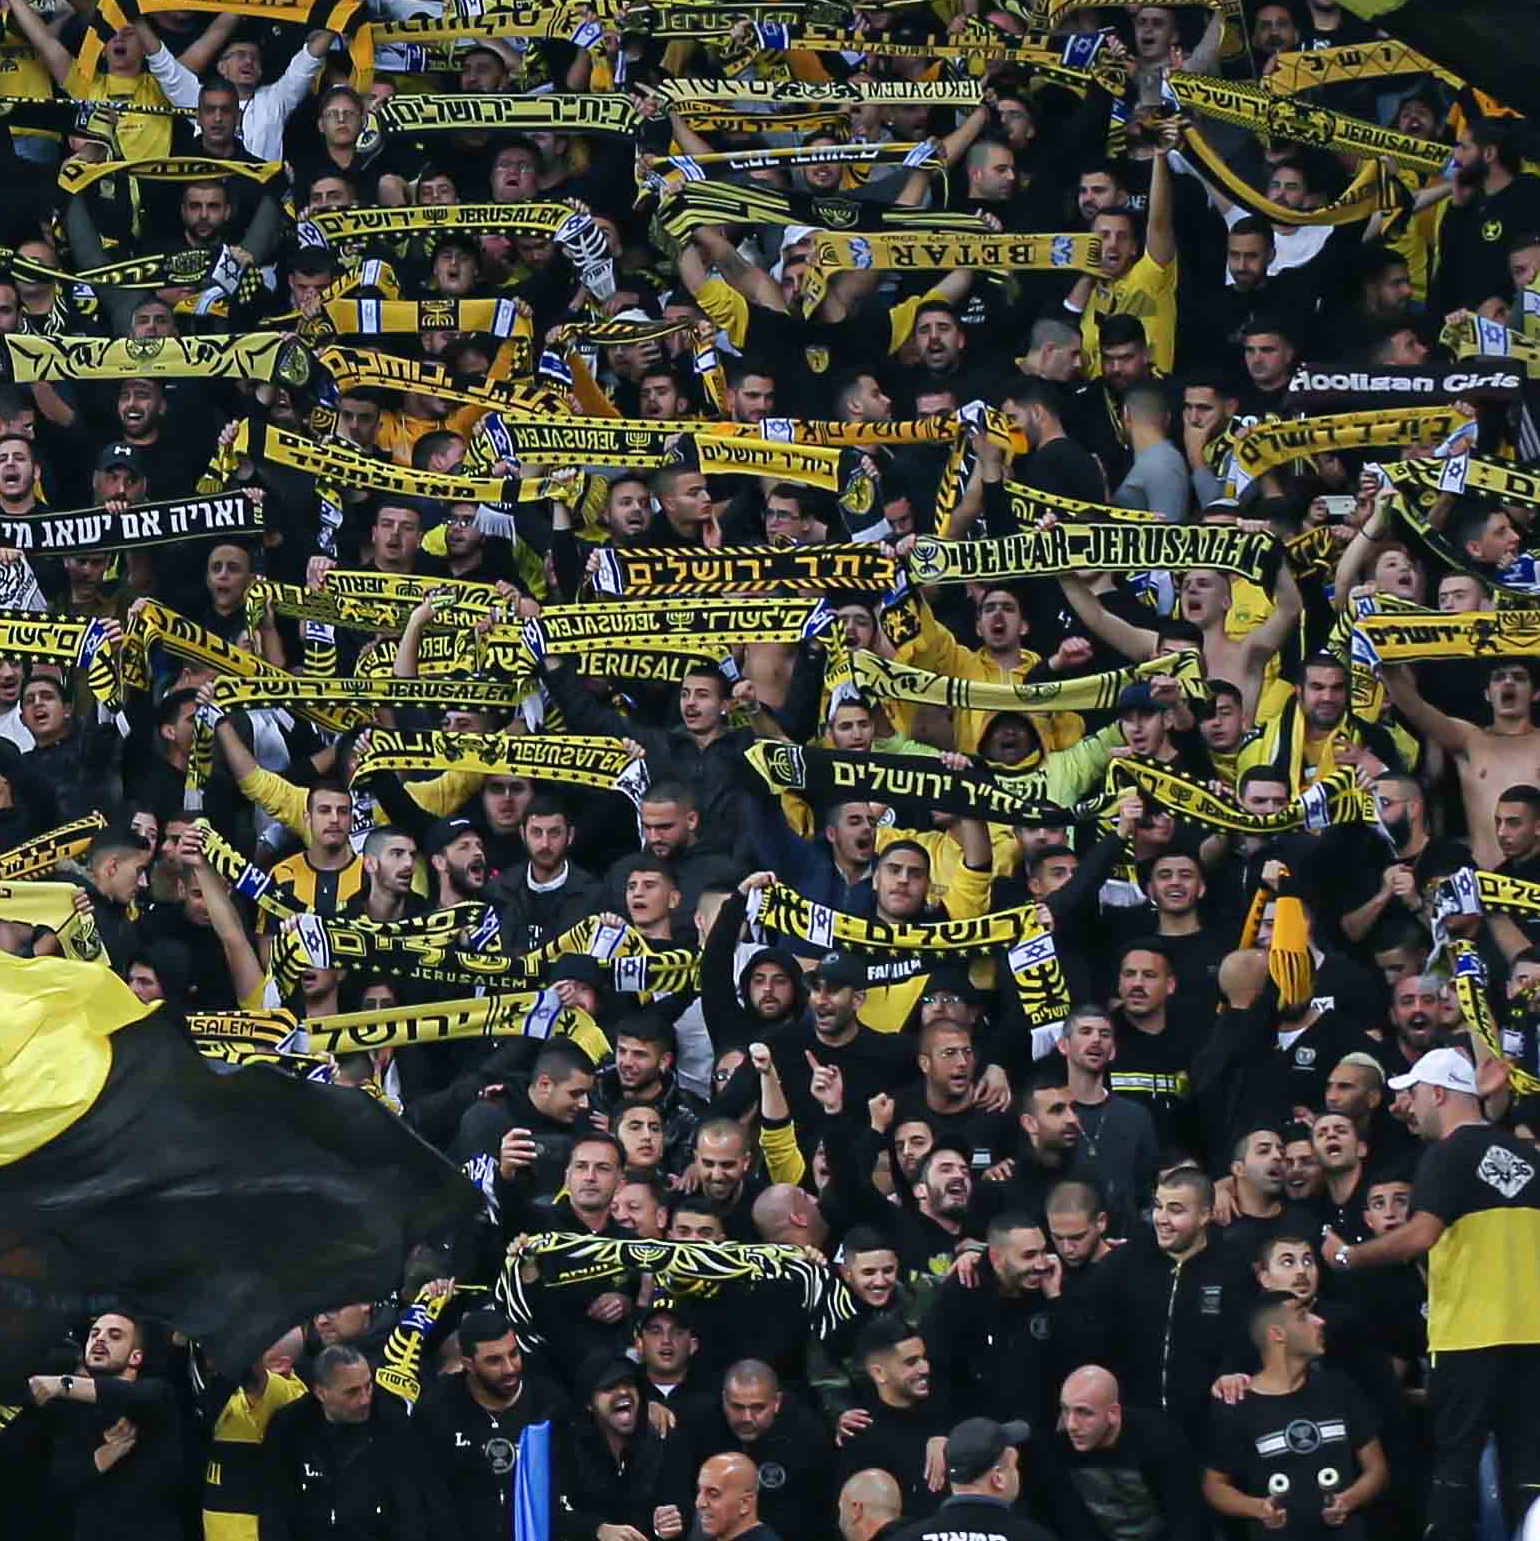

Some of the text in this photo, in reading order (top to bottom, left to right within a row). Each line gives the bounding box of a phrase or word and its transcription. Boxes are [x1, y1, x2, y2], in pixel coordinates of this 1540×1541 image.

[1174, 83, 1270, 121] ירושלים
[1336, 123, 1450, 164] JERUSALEM
[323, 209, 415, 239] ירושלים
[455, 207, 562, 227] JERUSALEM
[890, 243, 1032, 267] BETAR
[1443, 371, 1520, 392] Girls
[702, 443, 777, 464] ירושלים
[122, 504, 155, 540] אם
[178, 495, 246, 529] ואריה
[1, 519, 32, 551] מי
[40, 508, 113, 547] ישאג
[624, 558, 774, 584] ירושלים
[215, 677, 332, 703] ירושלים
[381, 679, 514, 703] JERUSALEM
[833, 762, 952, 801] ירושלים
[410, 967, 528, 989] JERUSALEM
